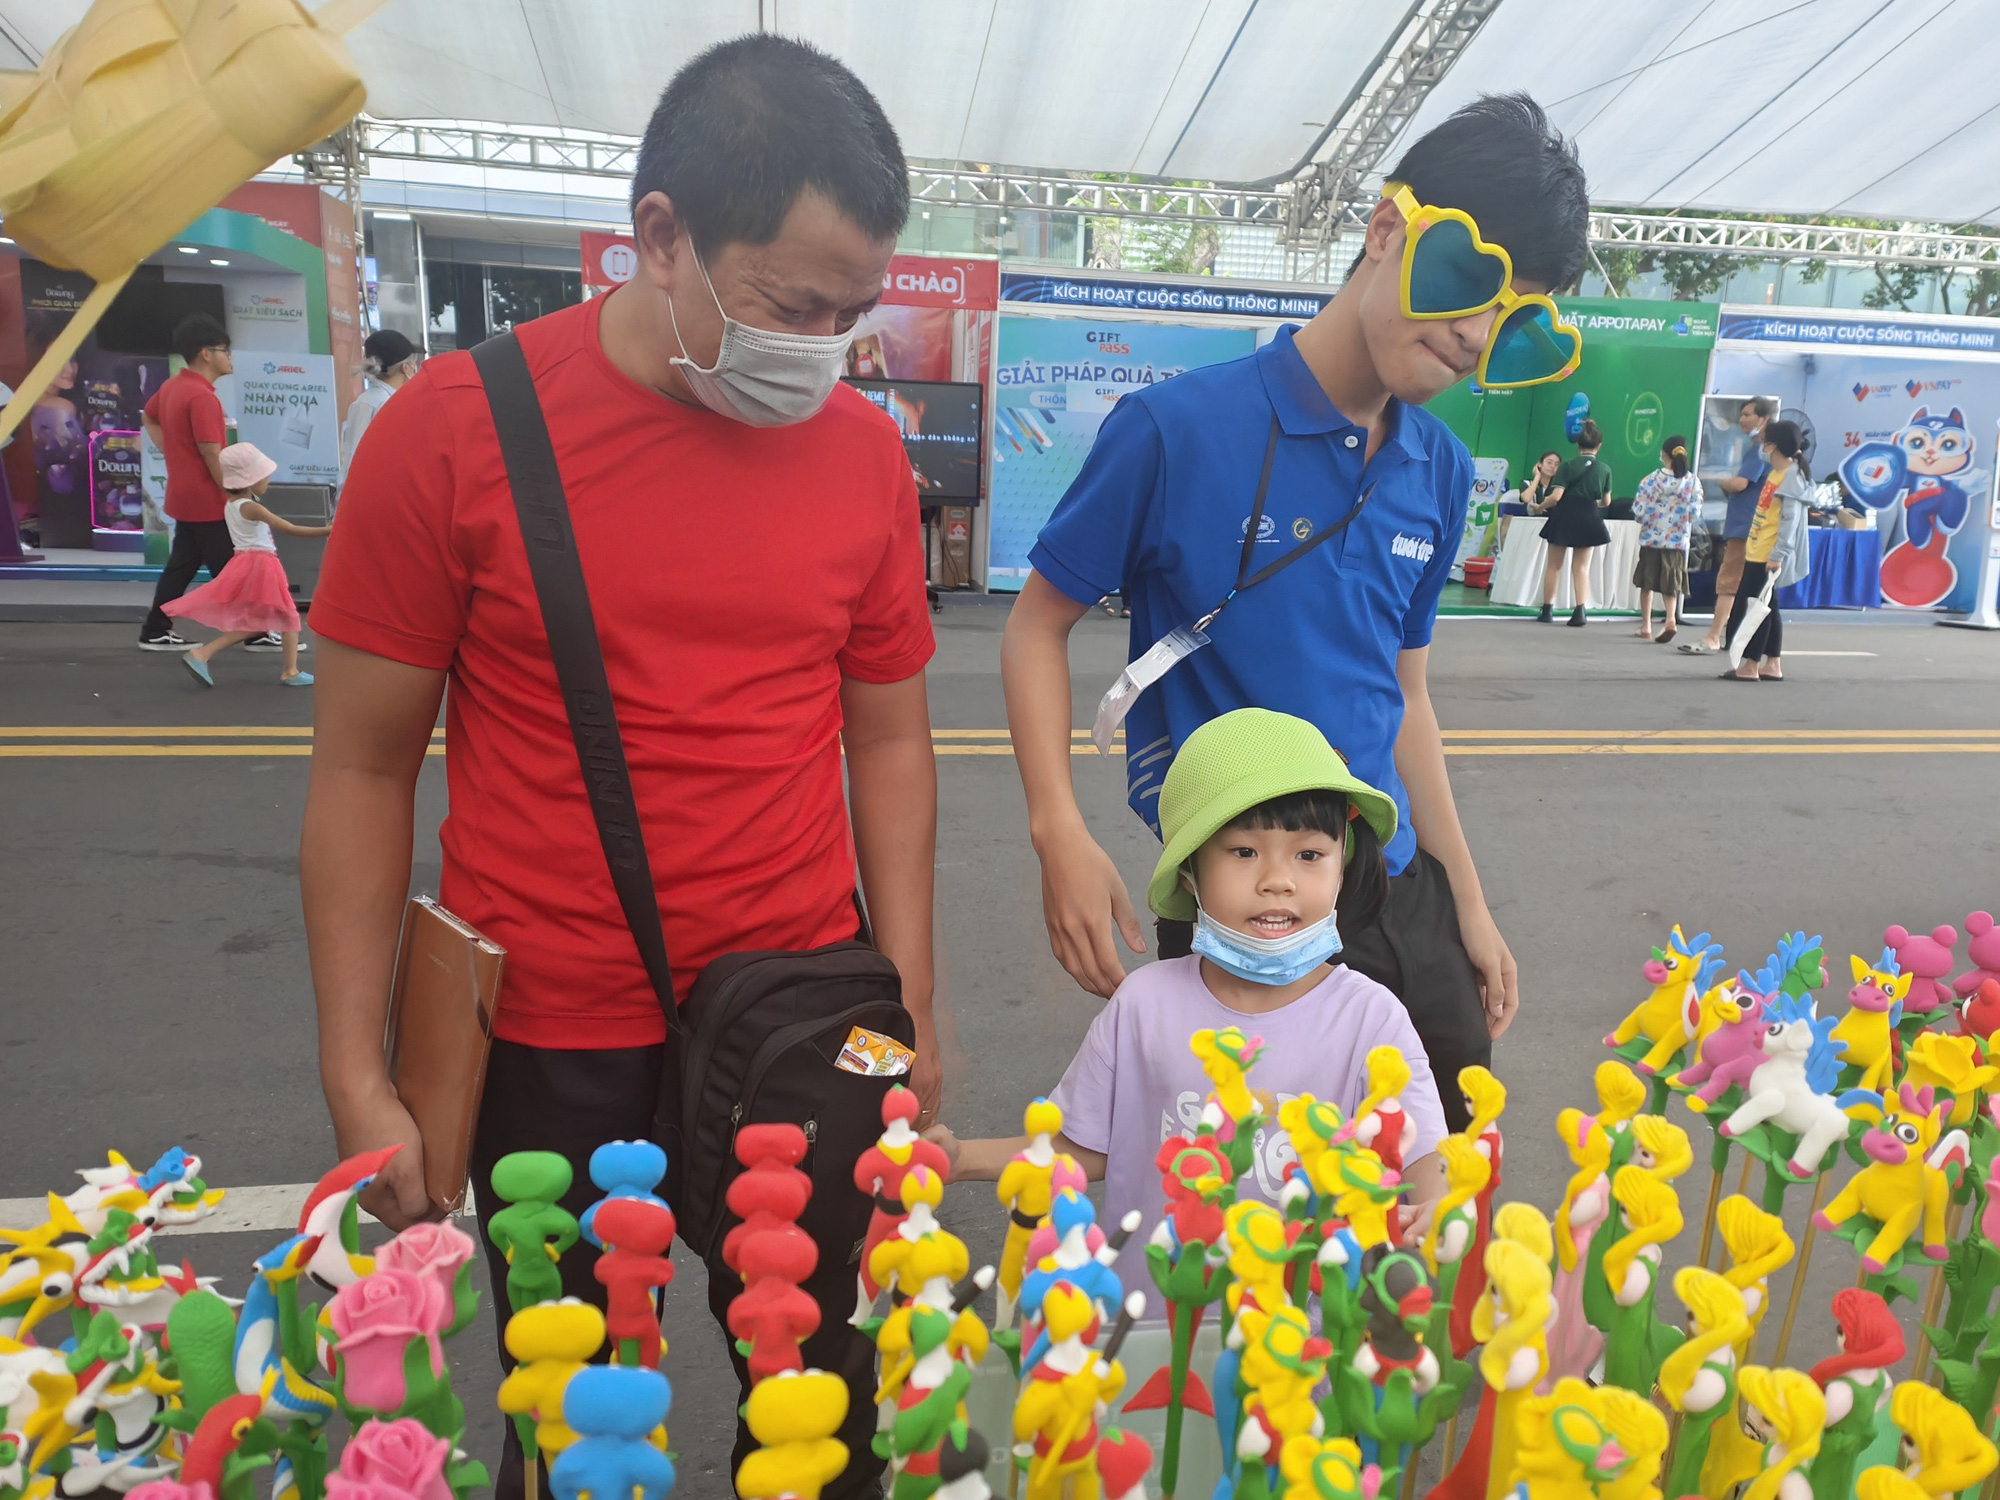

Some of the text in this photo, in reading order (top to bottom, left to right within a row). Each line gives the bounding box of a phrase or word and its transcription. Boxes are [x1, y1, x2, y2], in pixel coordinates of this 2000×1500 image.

[895, 270, 958, 294] CHÀO
[1053, 284, 1319, 314] KÍCH HOẠT CUỘC SỐNG THÔNG MINH
[1588, 315, 1667, 332] APPOTAPAY
[1086, 330, 1121, 343] GIFT
[1765, 321, 1995, 347] KÍCH HOẠT CUỘC SỐNG THÔNG MINH
[277, 365, 306, 374] ARIEL
[997, 360, 1046, 386] GIẢI
[1051, 361, 1107, 383] PHÁP
[1111, 365, 1154, 385] QUÀ
[243, 381, 270, 390] QUAY
[301, 384, 328, 393] ARIEL
[88, 396, 118, 408] Downy
[1038, 393, 1067, 404] THÔN
[98, 459, 142, 476] Downy
